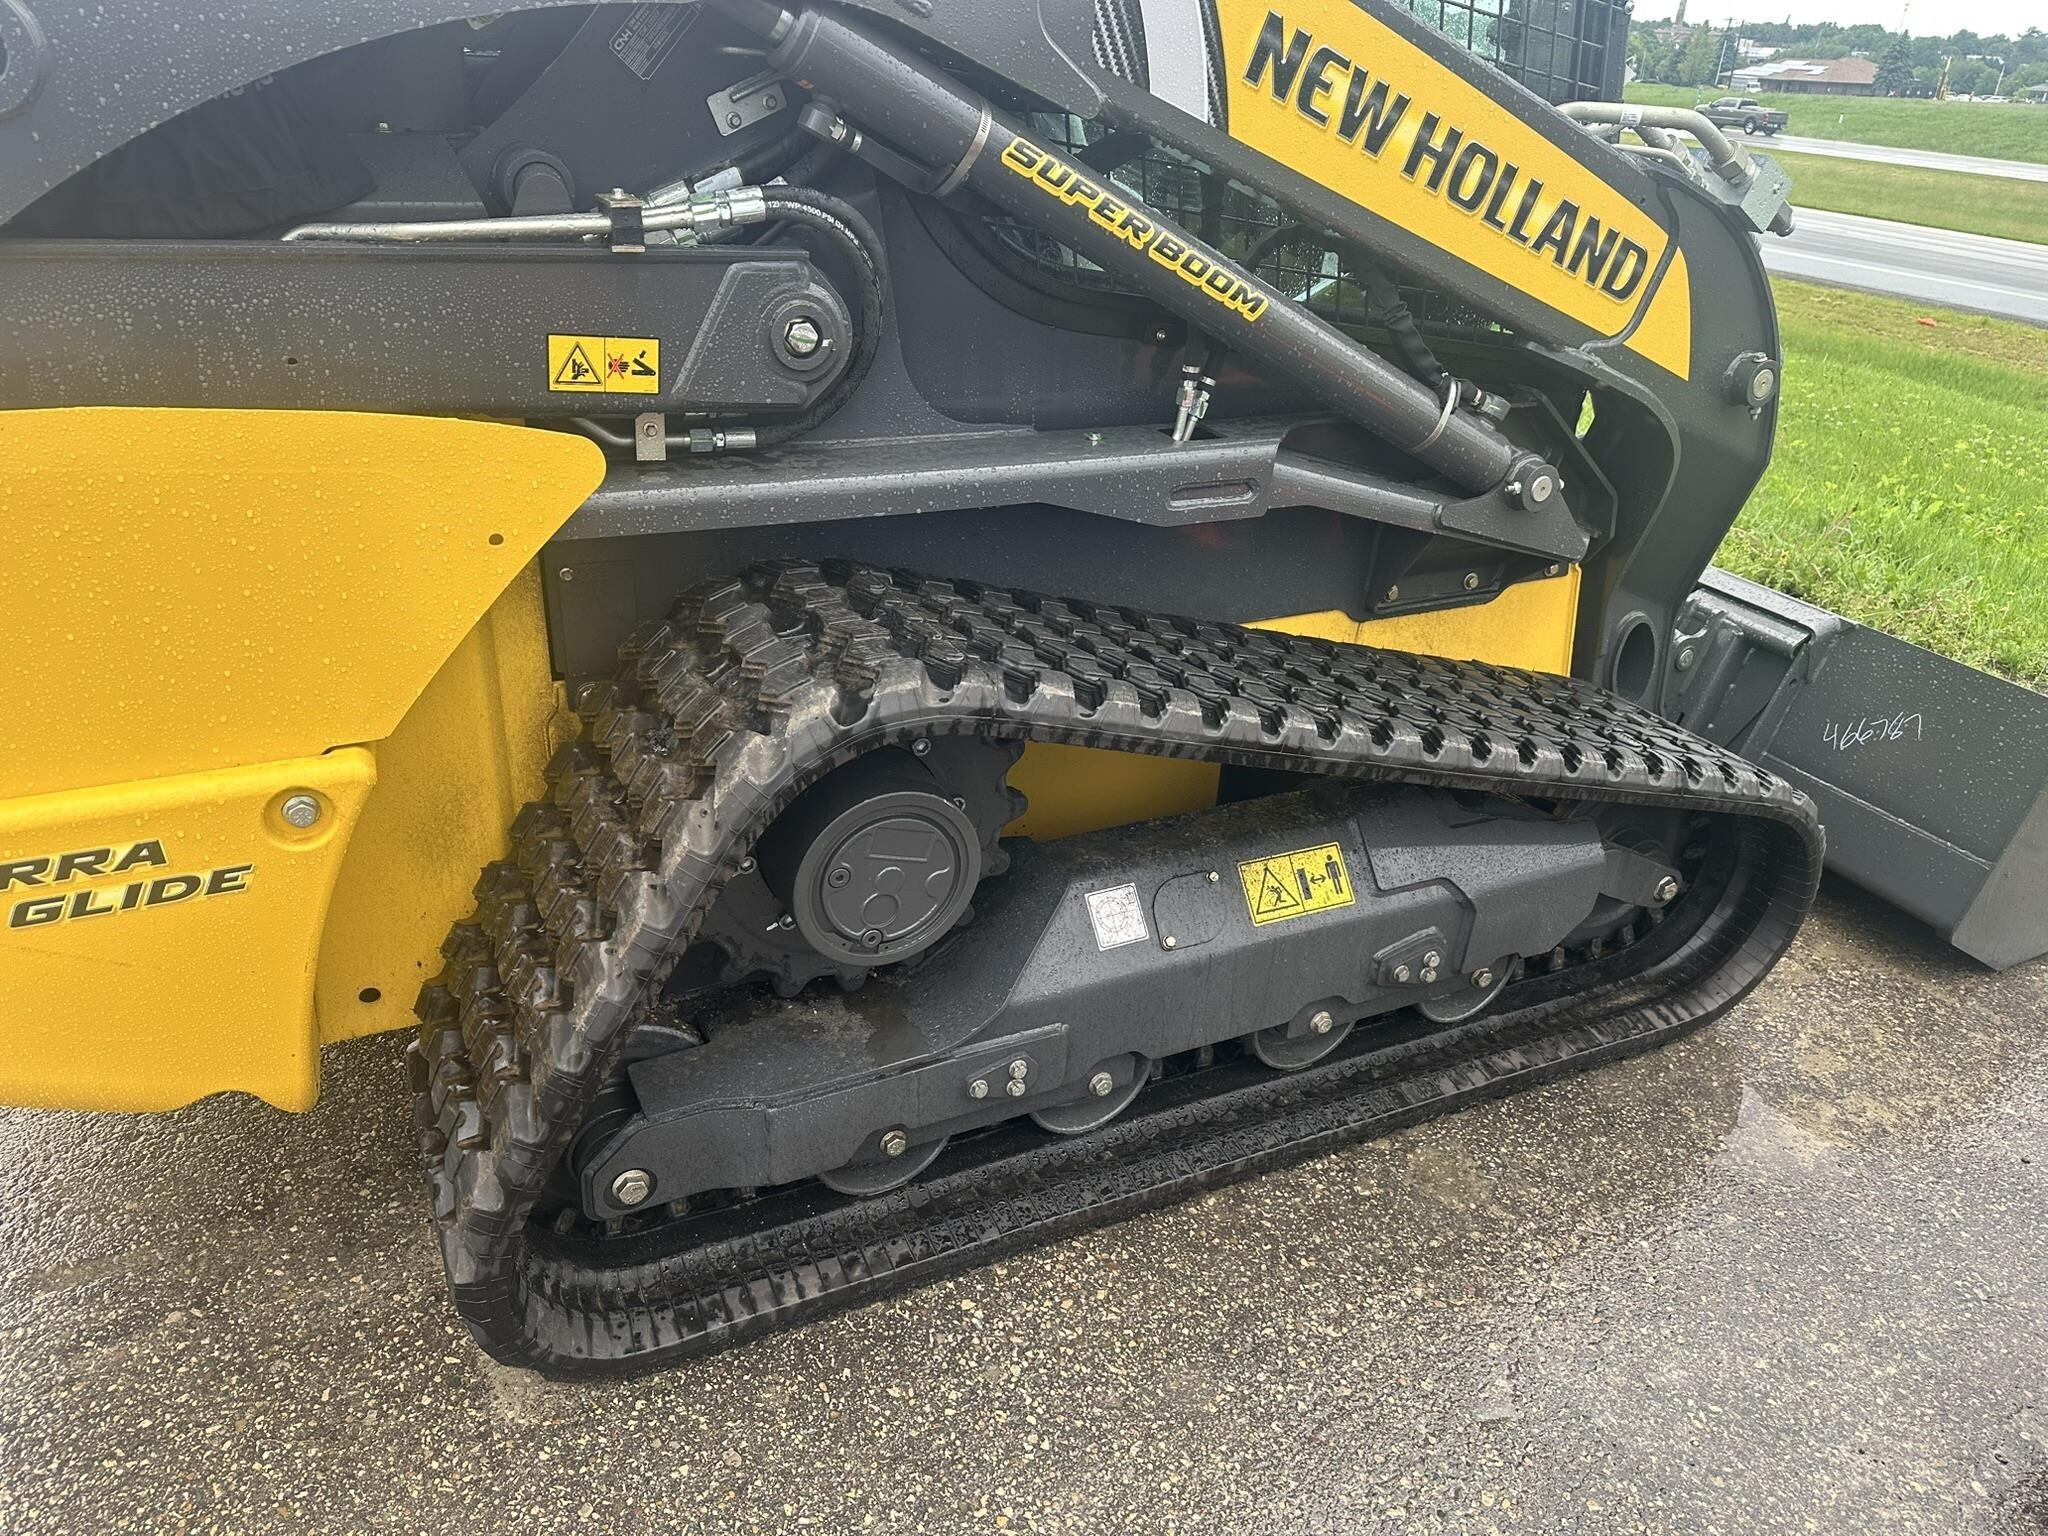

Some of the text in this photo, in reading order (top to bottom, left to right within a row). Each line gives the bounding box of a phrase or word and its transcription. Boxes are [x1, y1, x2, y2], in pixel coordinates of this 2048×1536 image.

[1002, 137, 1269, 322] SUPER BOOM
[1243, 9, 1650, 303] NEW HOLLAND
[9, 863, 253, 928] GLIDE
